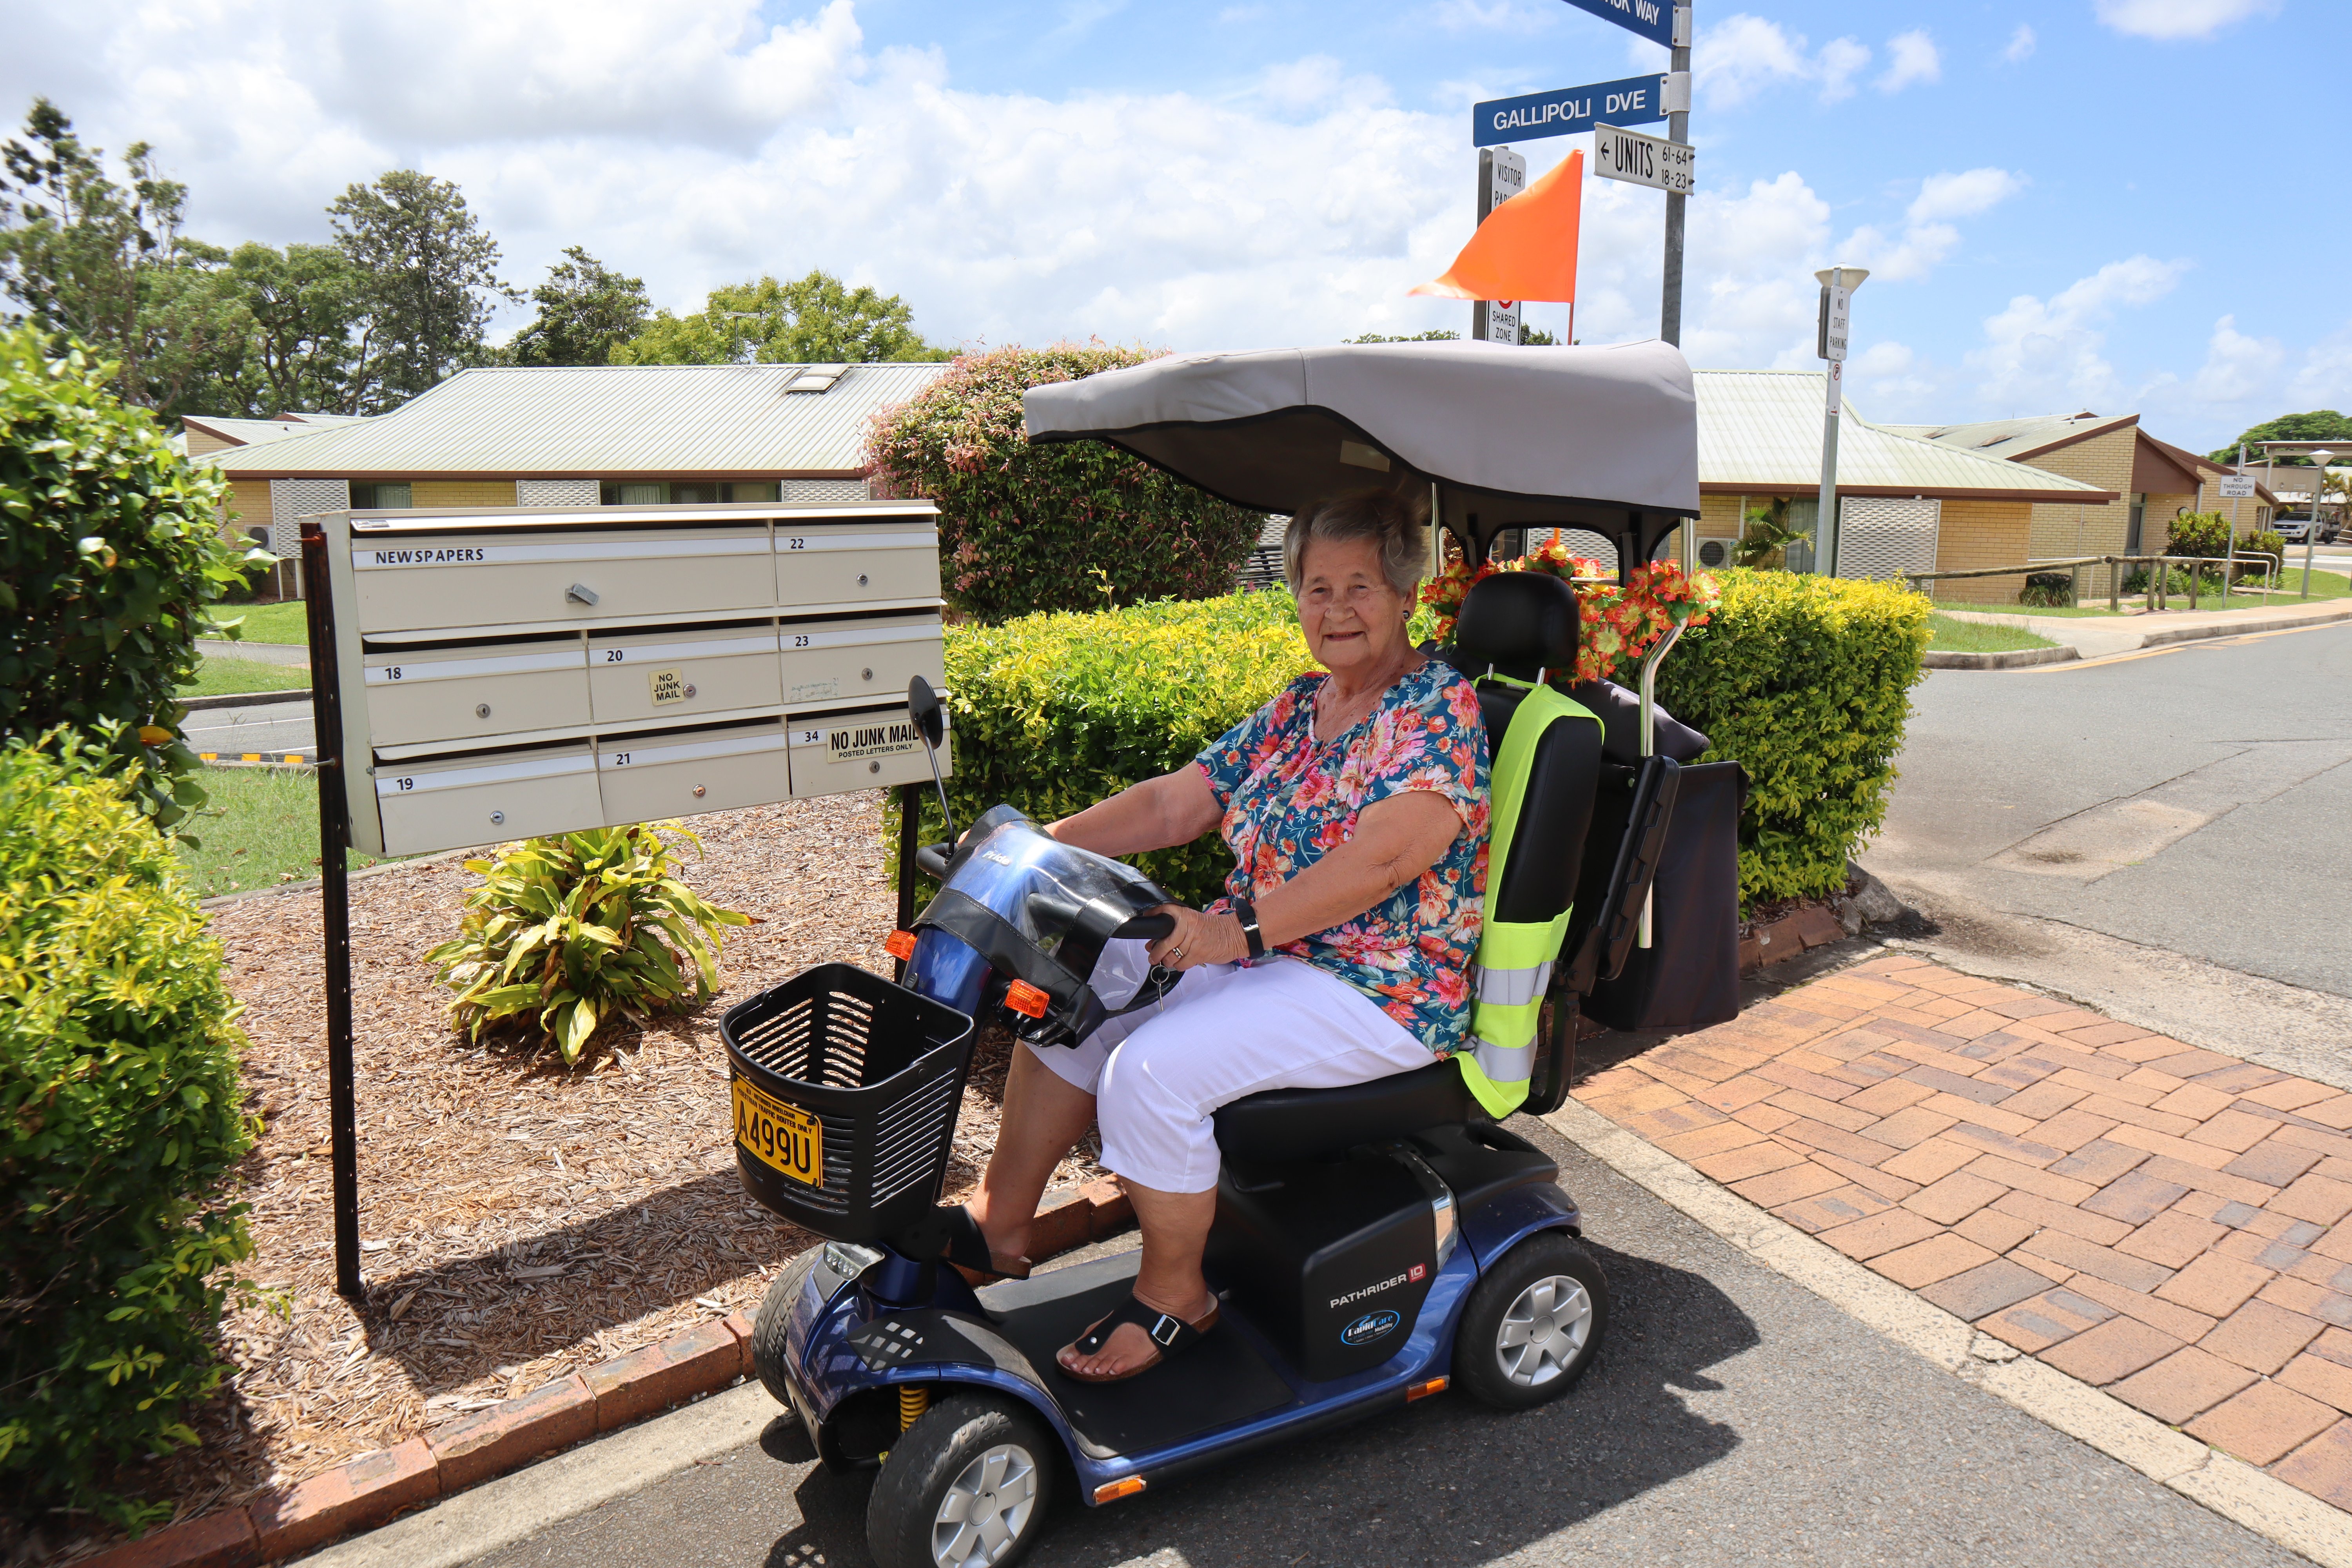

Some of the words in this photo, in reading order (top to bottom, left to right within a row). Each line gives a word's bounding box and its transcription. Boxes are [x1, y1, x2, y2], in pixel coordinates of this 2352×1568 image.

[1635, 0, 1659, 25] WAY
[1494, 98, 1590, 130] GALLIPOLI
[1606, 89, 1646, 114] DVE
[1616, 135, 1653, 178] UNITS
[1662, 146, 1686, 166] 61-64
[1498, 163, 1521, 187] VISITOR
[1662, 169, 1686, 189] 18-23
[1837, 298, 1843, 310] NO
[1492, 310, 1515, 327] SHARED
[1833, 317, 1845, 330] STAFF
[1496, 327, 1511, 341] ZONE
[1829, 336, 1846, 350] PARKING
[790, 538, 804, 549] 22
[376, 548, 484, 564] NEWSPAPERS
[795, 635, 809, 647] 23
[607, 650, 623, 662] 20
[385, 667, 401, 680] 18
[659, 673, 673, 682] NO
[654, 681, 680, 692] JUNK
[656, 690, 680, 701] MAIL
[805, 731, 818, 742] 34
[831, 731, 848, 750] NO
[853, 727, 885, 748] JUNK
[889, 724, 919, 742] MAIL
[616, 753, 630, 765] 21
[838, 750, 864, 758] POSTED
[866, 746, 894, 755] LETTERS
[396, 778, 413, 791] 19
[982, 850, 1010, 865] Pride
[737, 1087, 757, 1108] PEDESTRIAN
[759, 1103, 775, 1118] TRAFFIC
[776, 1114, 796, 1128] ROUTES
[797, 1124, 812, 1134] ONLY
[772, 1103, 796, 1120] WHEELCHAIR
[738, 1100, 811, 1174] A499U
[1330, 1274, 1406, 1308] PATHRIDER
[1375, 1323, 1393, 1332] Mobility
